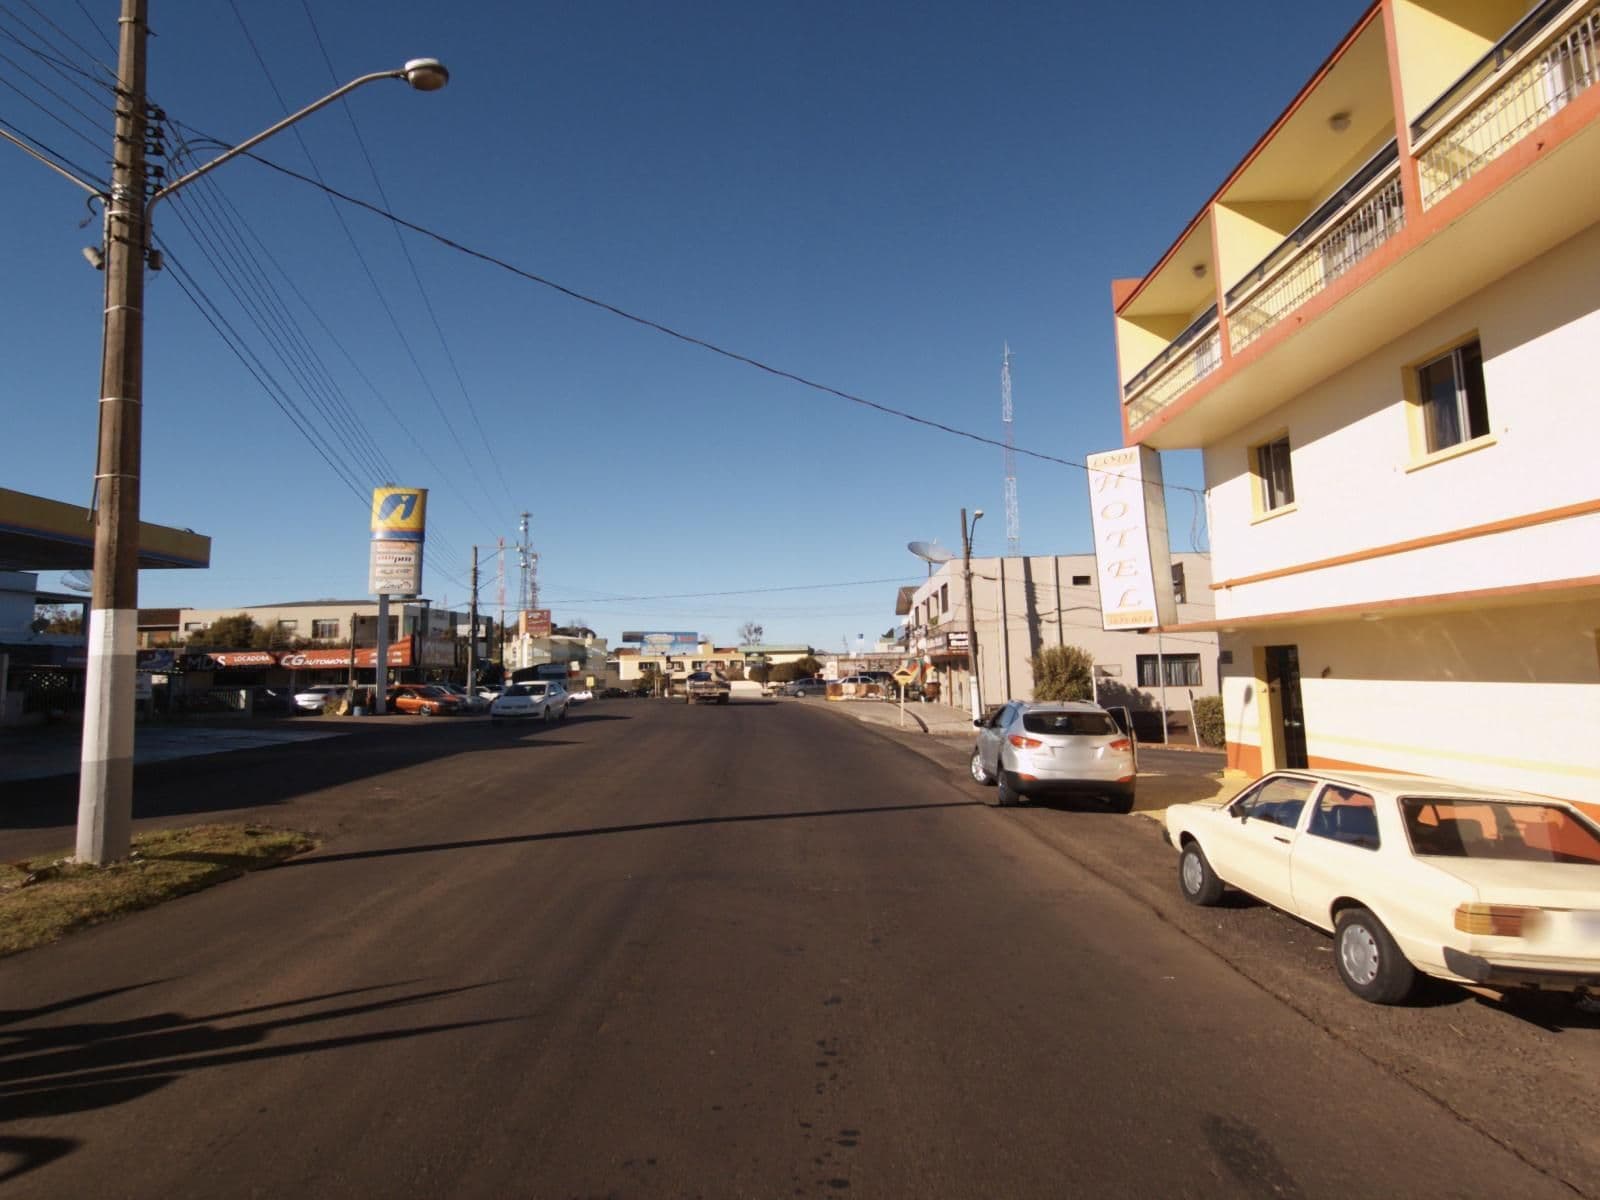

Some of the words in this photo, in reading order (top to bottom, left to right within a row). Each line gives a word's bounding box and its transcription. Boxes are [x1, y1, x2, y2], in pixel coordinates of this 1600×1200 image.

[1096, 469, 1142, 608] HOTEL
[233, 655, 270, 663] LOCADORA
[281, 654, 306, 666] CG
